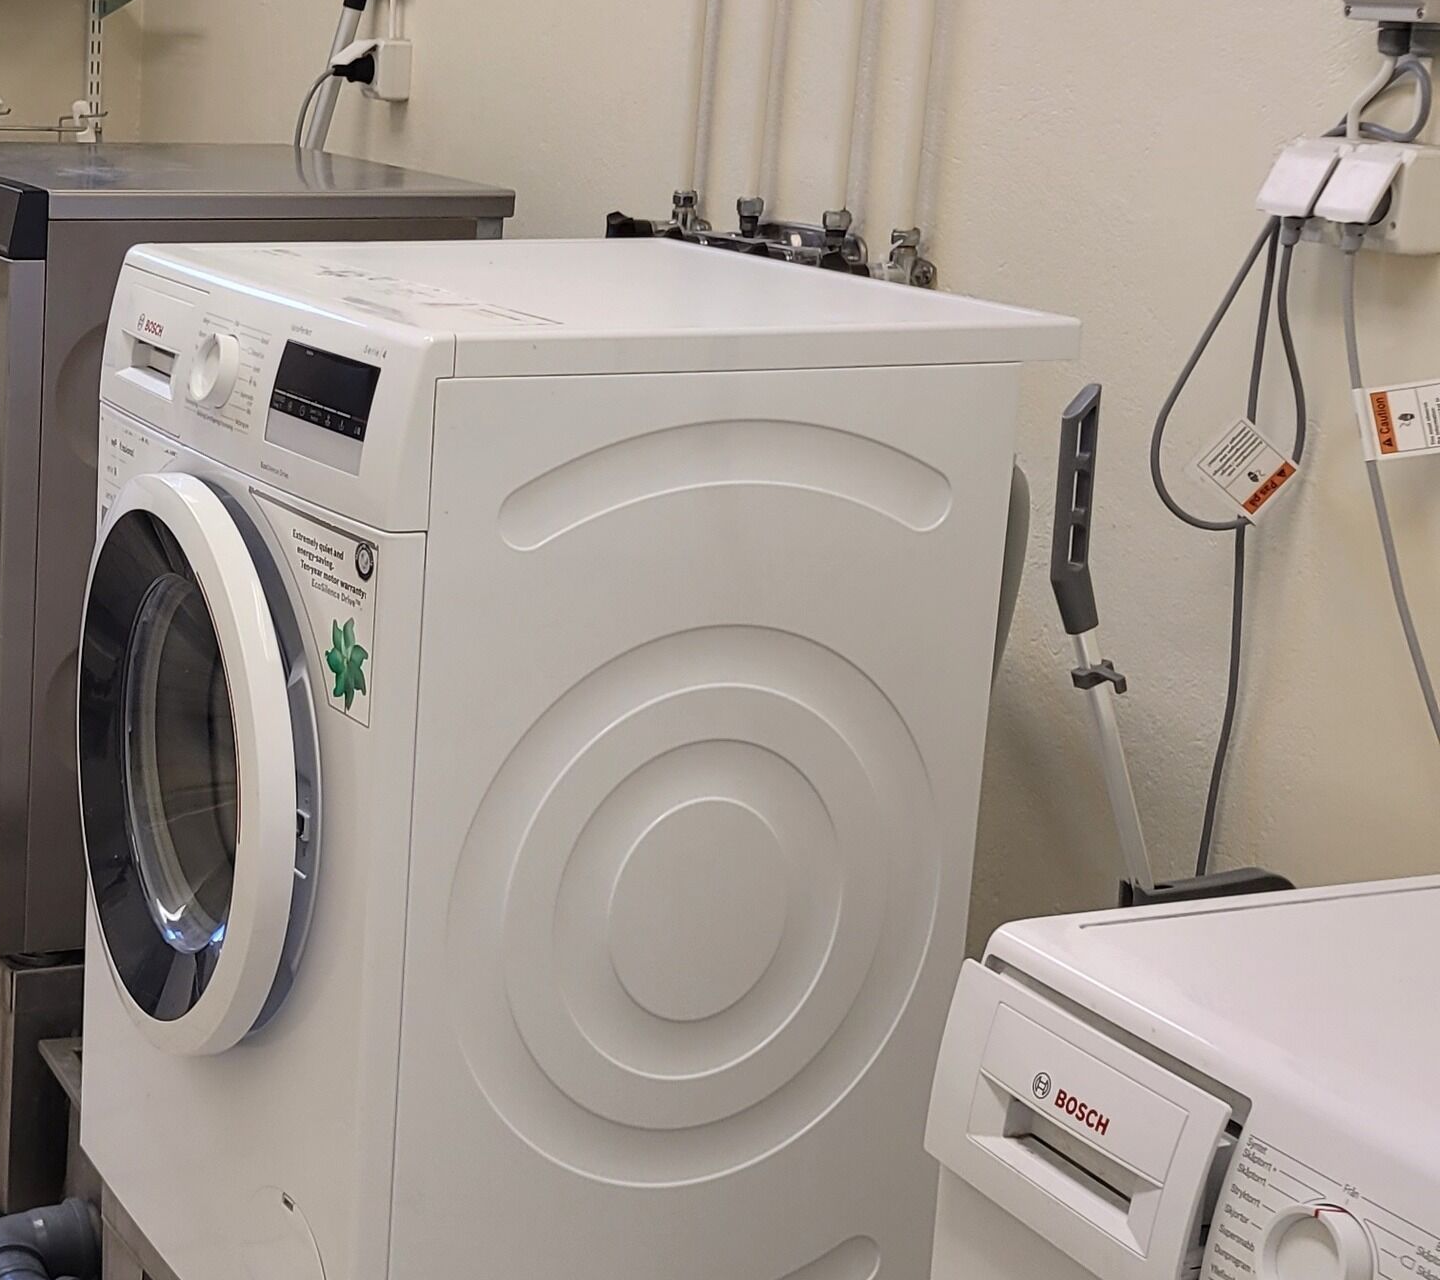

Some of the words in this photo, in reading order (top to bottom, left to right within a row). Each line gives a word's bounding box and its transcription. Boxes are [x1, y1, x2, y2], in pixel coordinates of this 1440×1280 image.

[144, 319, 164, 337] BOSCH
[1376, 397, 1391, 434] Caution
[1261, 480, 1277, 495] Pas
[292, 528, 319, 550] Extremely
[318, 542, 333, 556] quiet
[333, 548, 344, 561] and
[323, 570, 340, 586] motor
[1054, 1088, 1111, 1136] BOSCH
